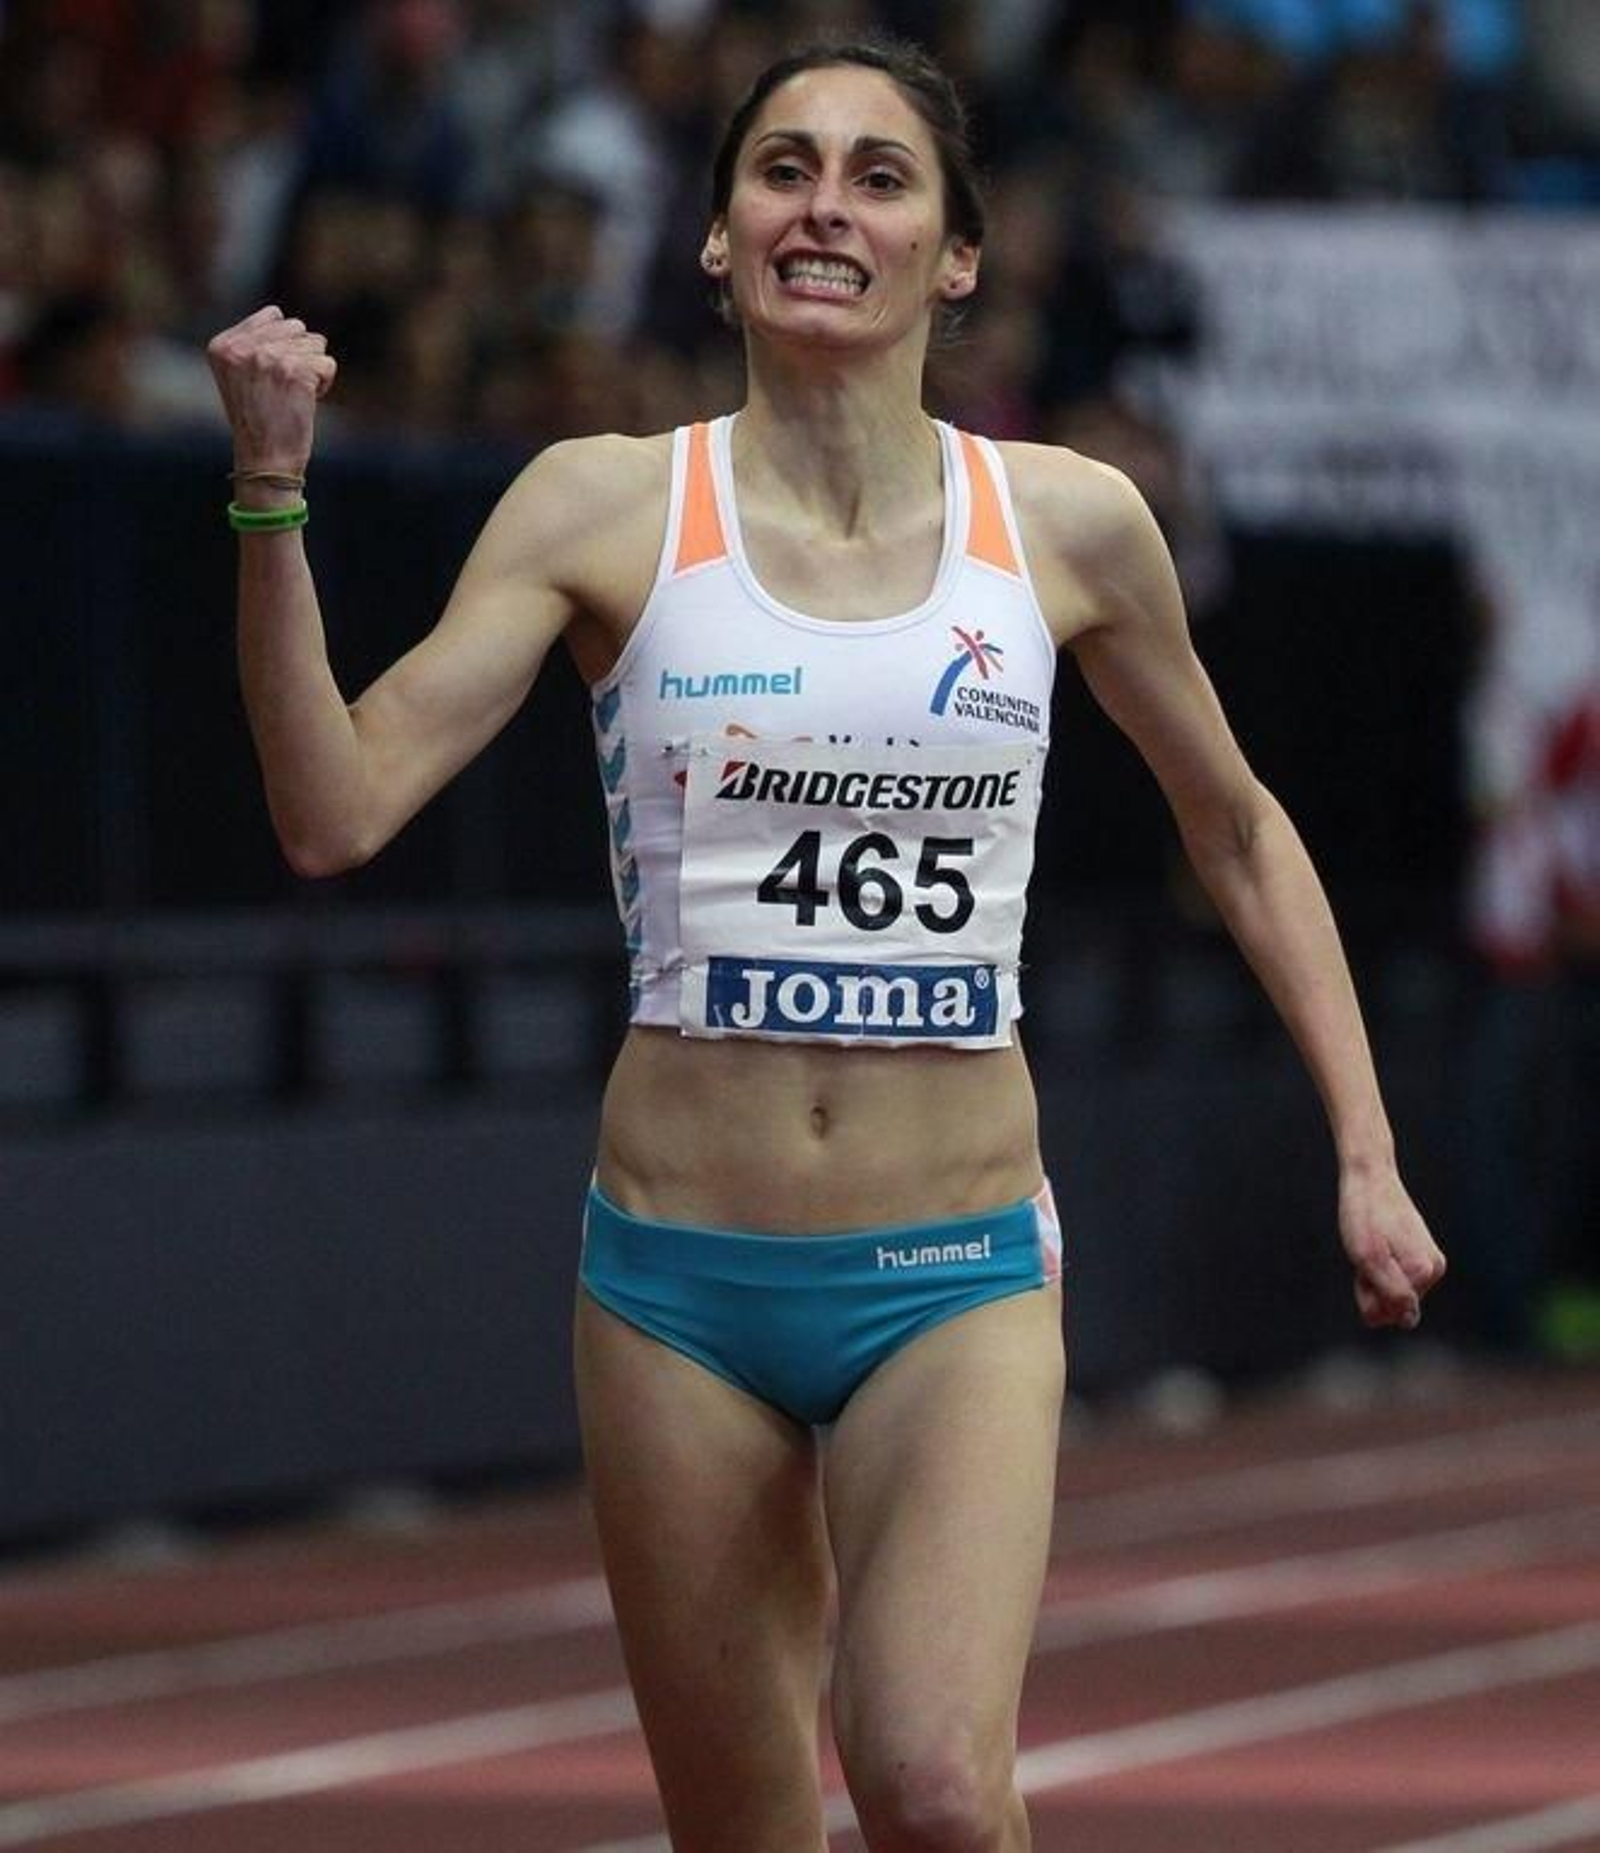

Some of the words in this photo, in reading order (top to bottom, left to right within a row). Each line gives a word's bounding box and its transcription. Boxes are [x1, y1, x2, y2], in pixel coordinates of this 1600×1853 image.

[660, 666, 802, 699] hummel
[954, 702, 1040, 733] VALENCIANA
[715, 760, 1020, 810] BRIDGESTONE
[757, 830, 976, 934] 465
[877, 1234, 990, 1270] hummel
